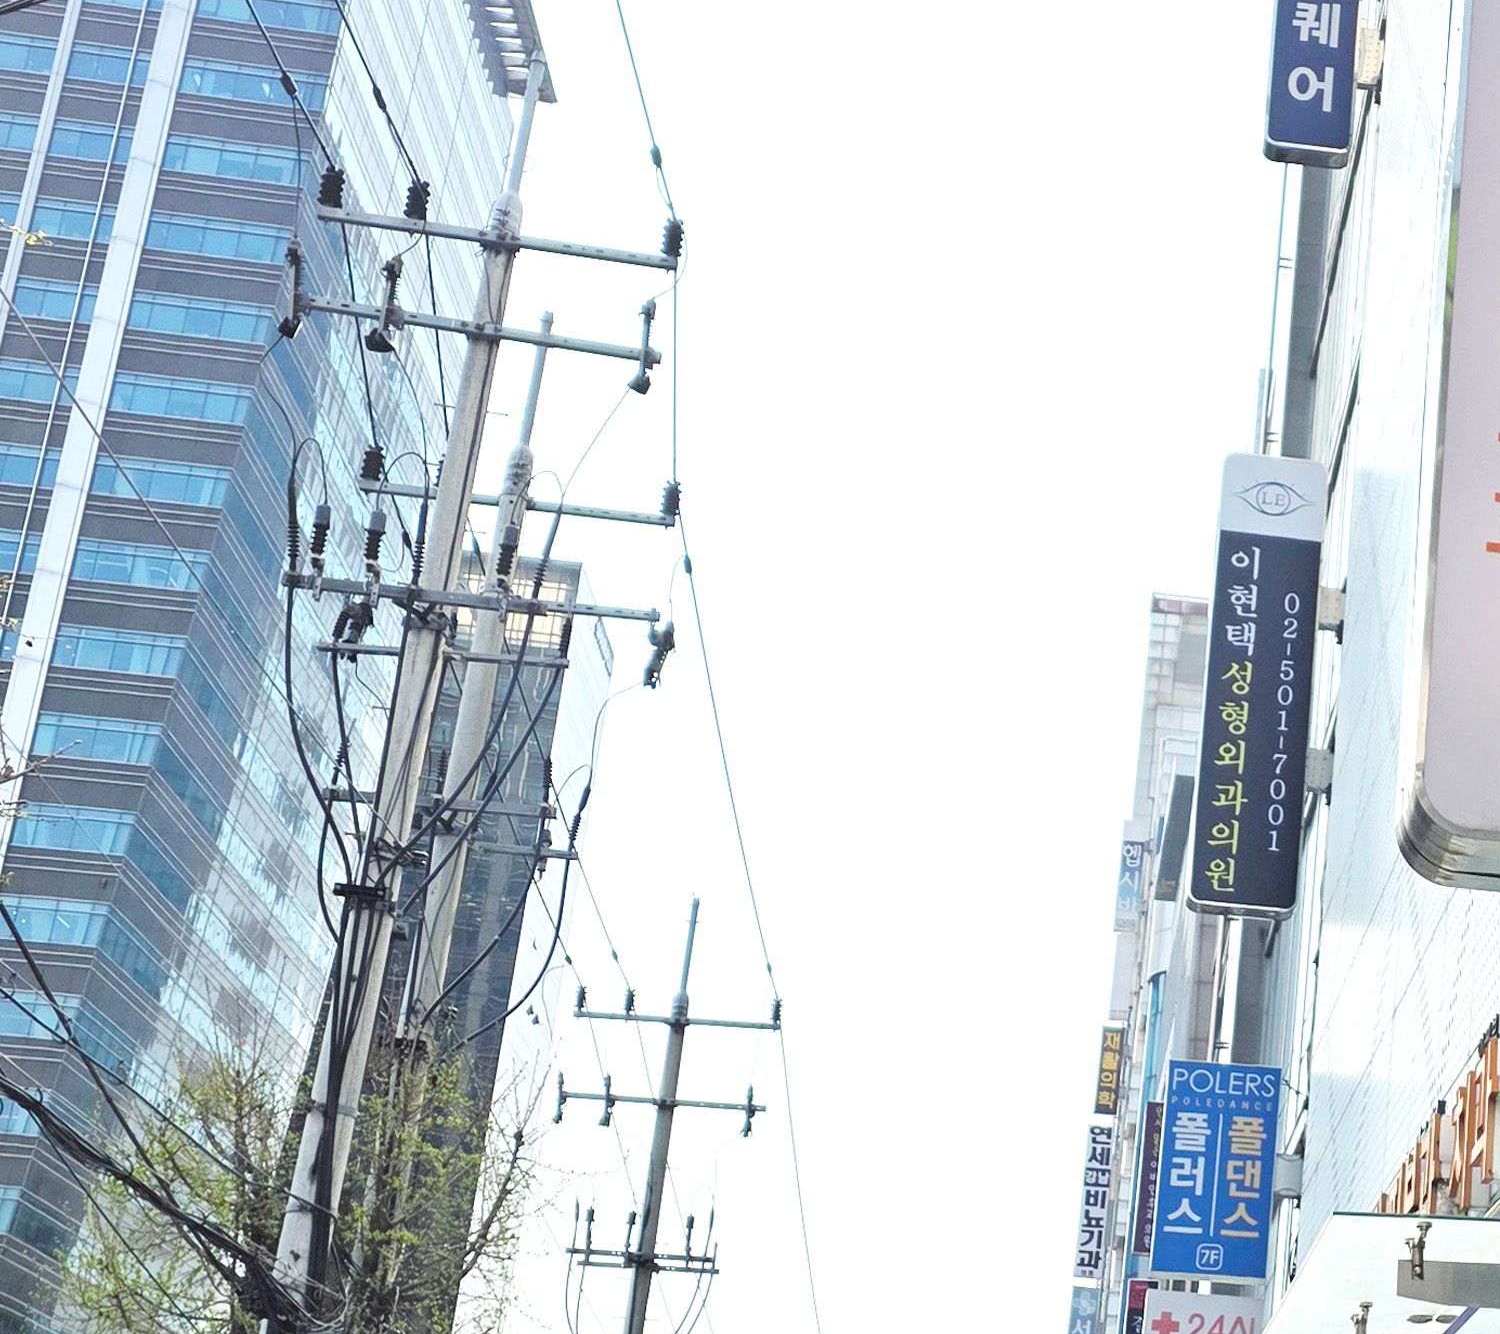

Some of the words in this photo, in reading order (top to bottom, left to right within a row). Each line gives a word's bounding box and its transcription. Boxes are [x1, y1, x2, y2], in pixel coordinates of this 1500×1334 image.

[1261, 490, 1287, 508] LE
[1267, 593, 1300, 852] 02-501-7001
[1173, 1068, 1275, 1098] POLERS
[1171, 1095, 1273, 1112] POLEDANCE
[1163, 1111, 1211, 1235] 폴러스
[1220, 1116, 1267, 1239] 폴댄스
[1200, 1249, 1220, 1266] 7F
